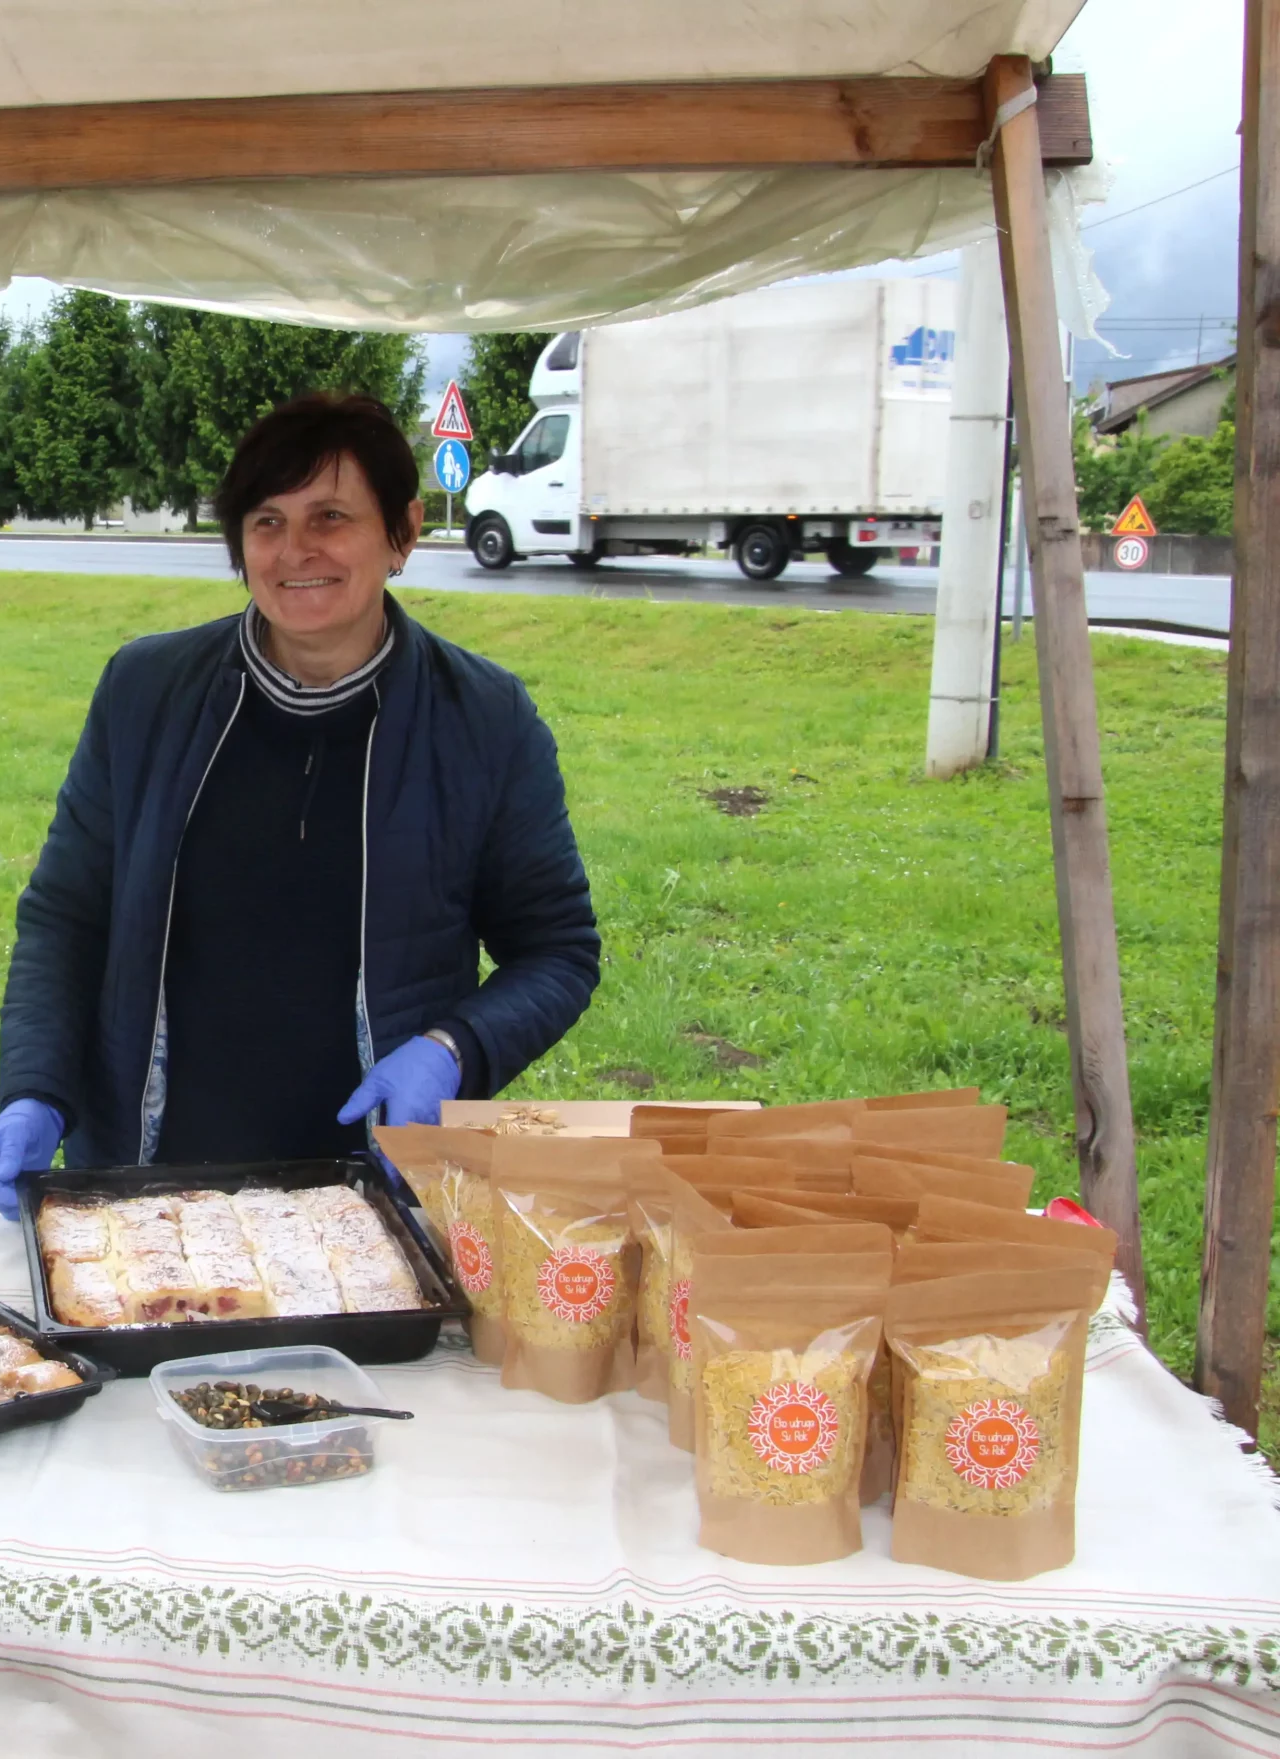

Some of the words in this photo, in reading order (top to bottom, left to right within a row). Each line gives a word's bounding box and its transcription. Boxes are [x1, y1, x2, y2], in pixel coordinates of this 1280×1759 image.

[1120, 545, 1140, 561] 30
[789, 1416, 816, 1431] udruga
[988, 1430, 1014, 1446] udruga
